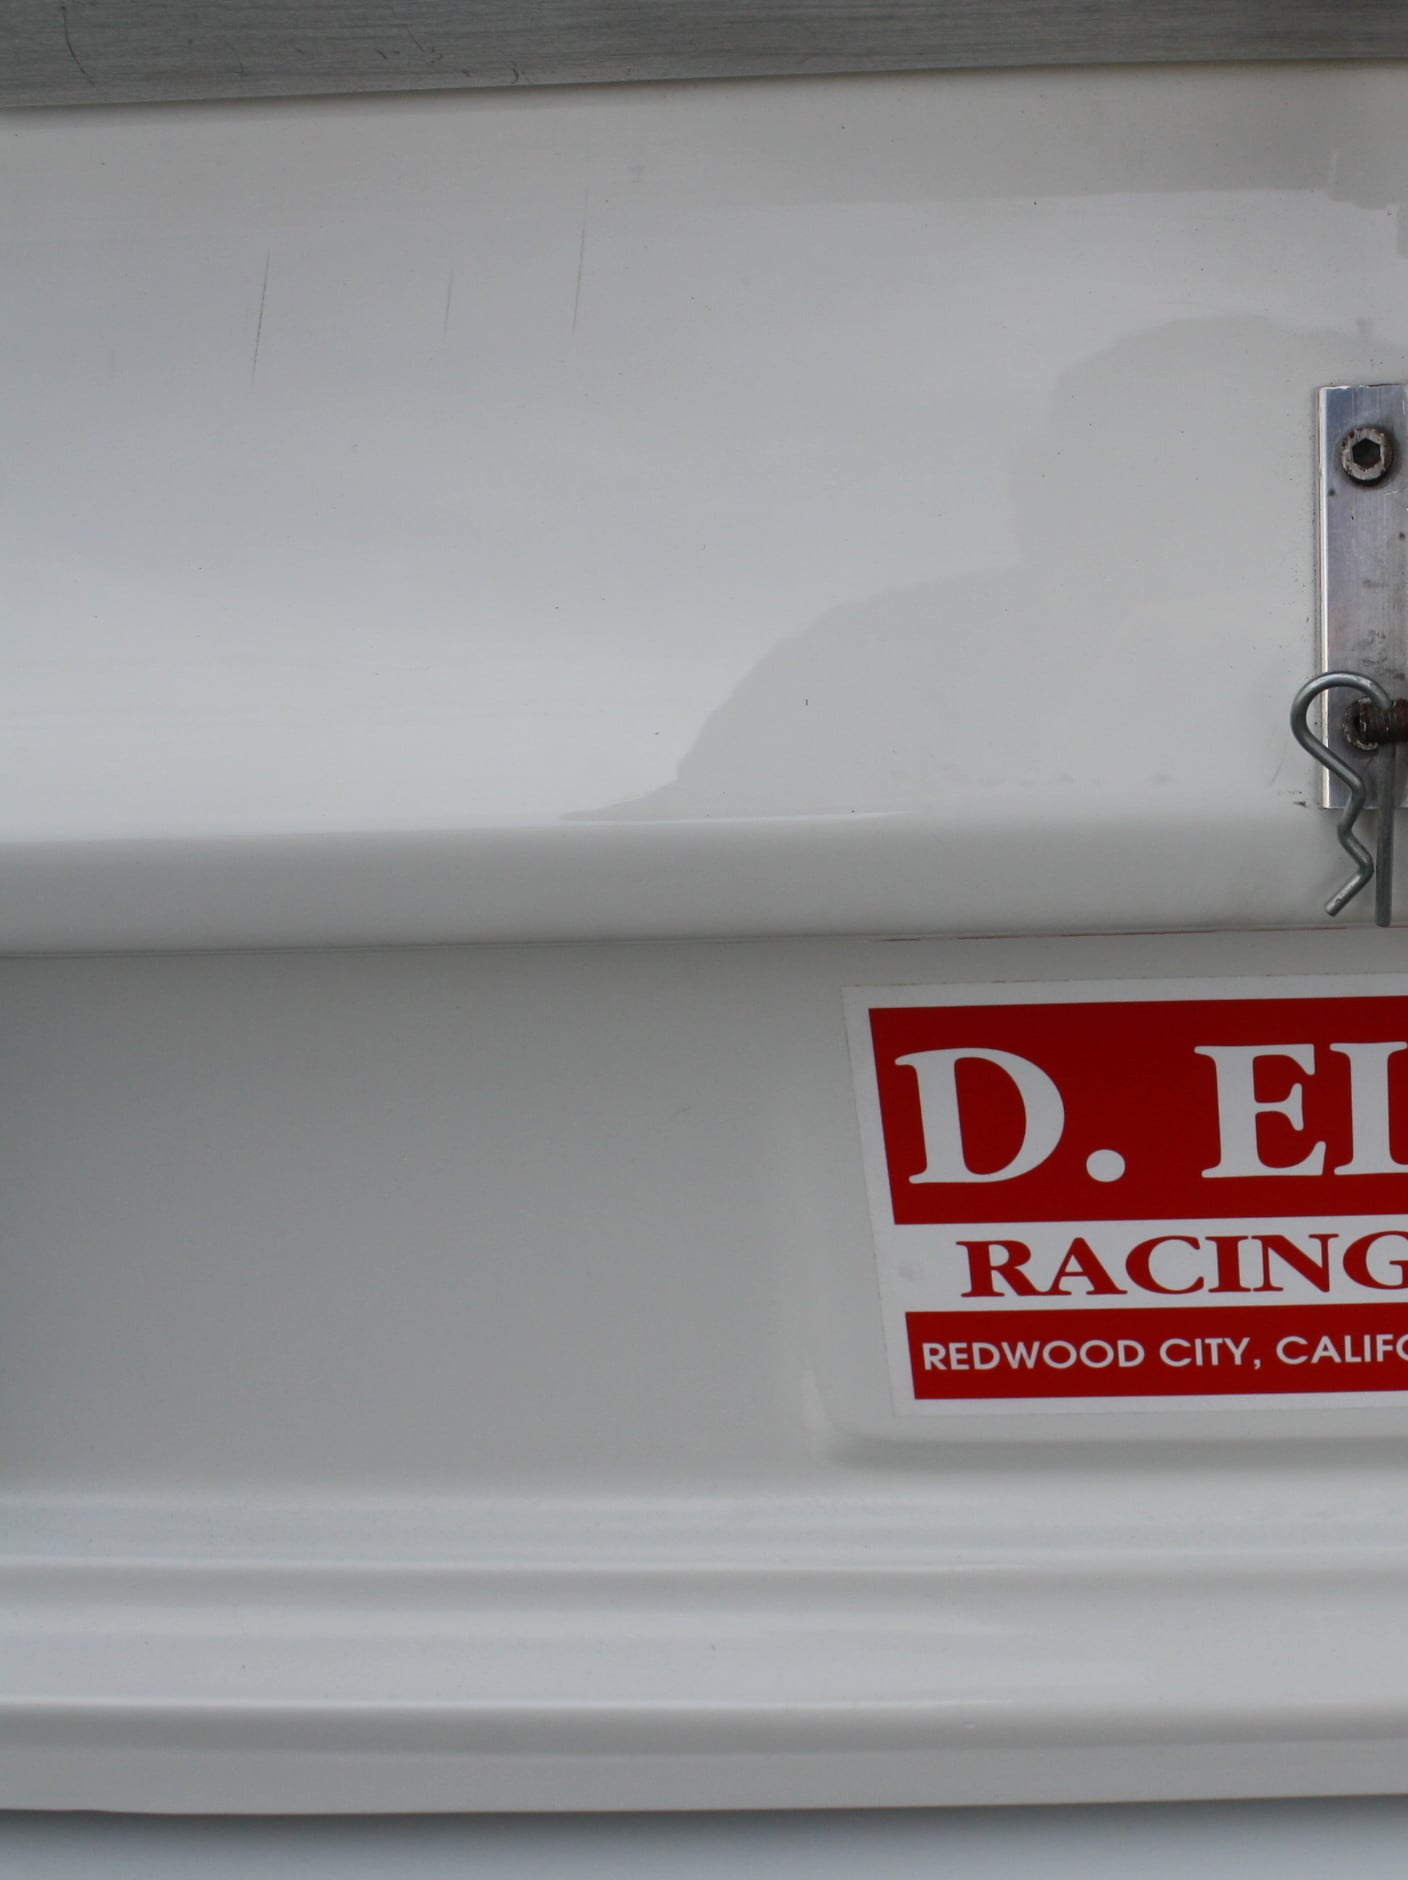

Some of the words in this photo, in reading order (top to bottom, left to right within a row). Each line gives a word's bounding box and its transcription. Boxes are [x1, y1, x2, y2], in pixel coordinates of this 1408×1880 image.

[894, 1046, 1127, 1184] D.
[922, 1338, 1145, 1371] REDWOOD
[1159, 1336, 1263, 1370] CITY,
